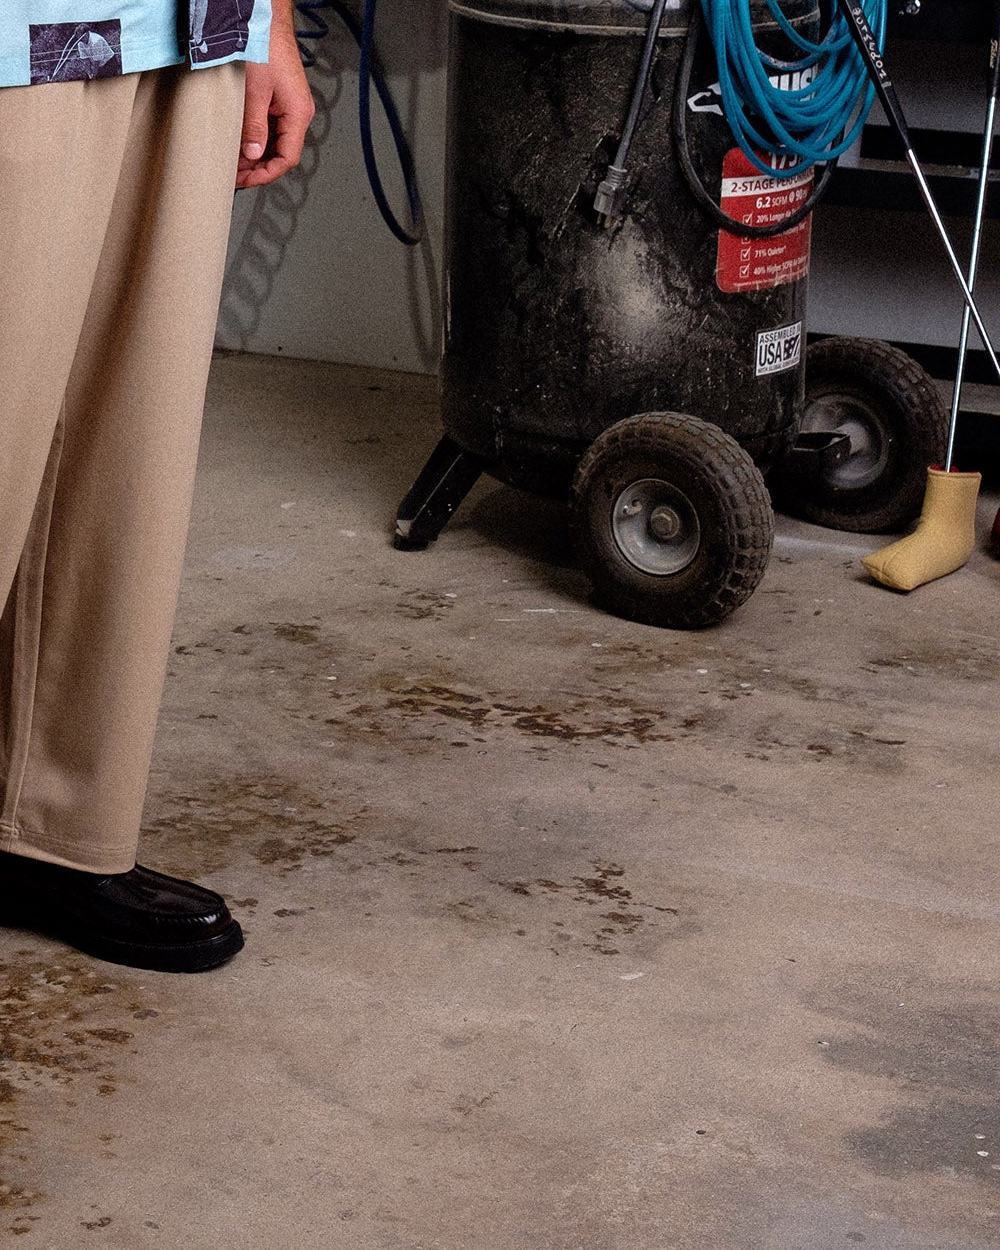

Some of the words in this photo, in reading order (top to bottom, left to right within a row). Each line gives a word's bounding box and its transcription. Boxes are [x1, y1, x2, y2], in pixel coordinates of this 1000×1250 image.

[731, 178, 774, 193] 2-STAGE
[756, 196, 771, 209] 6.2
[760, 325, 796, 344] ASSEMBLED
[759, 340, 782, 367] USA
